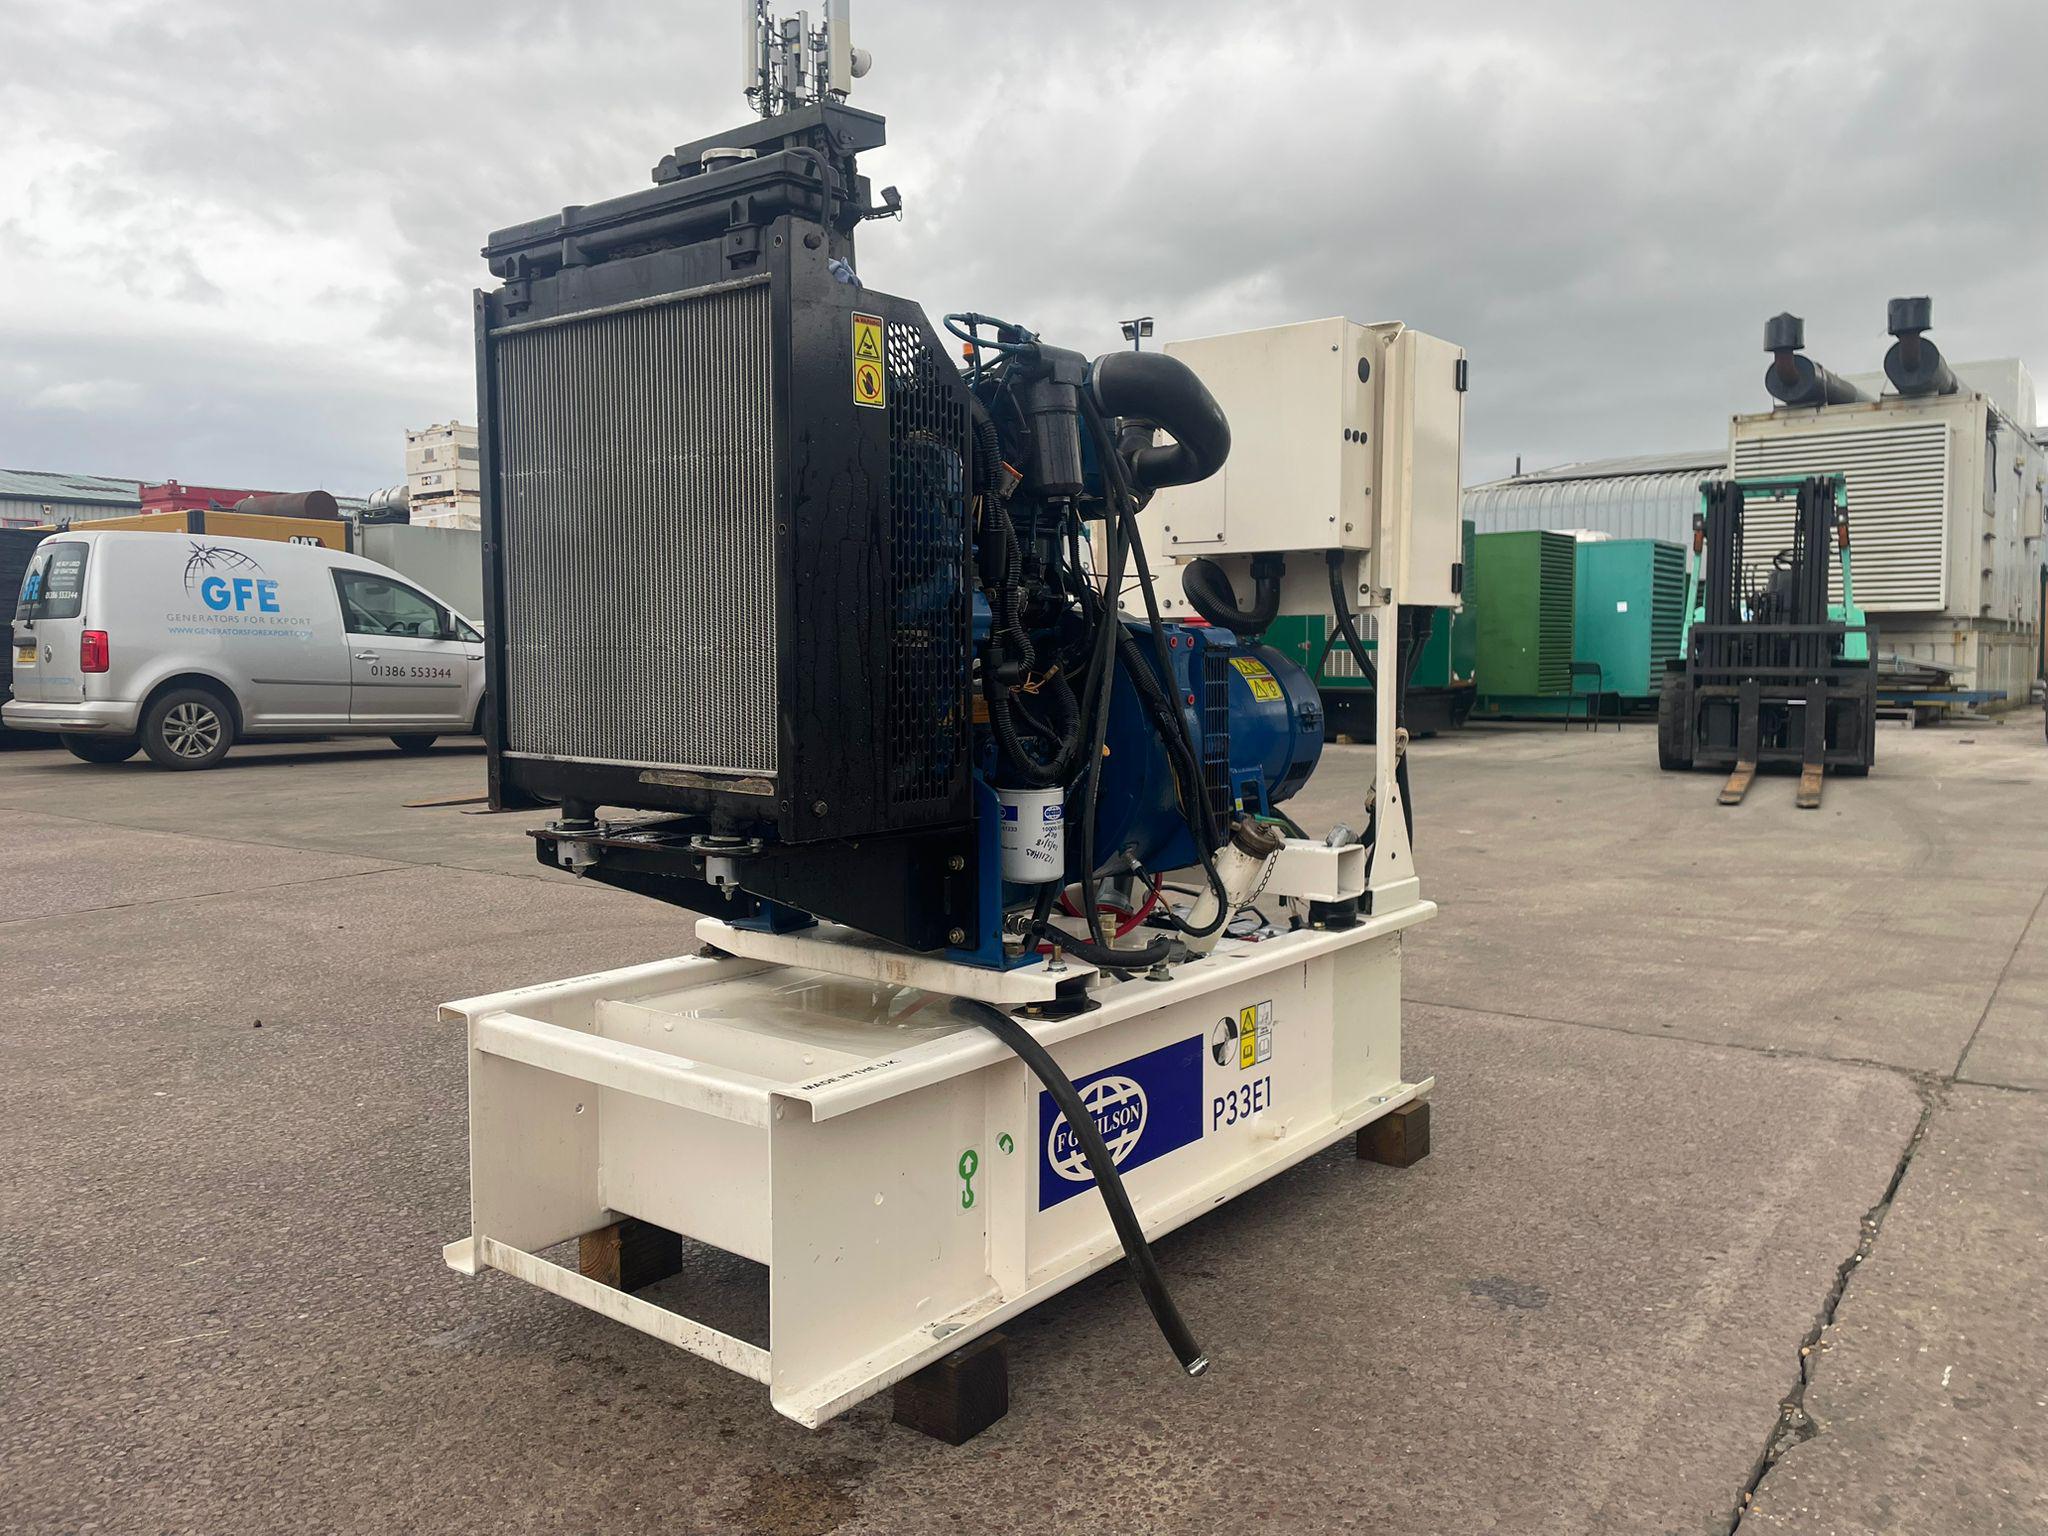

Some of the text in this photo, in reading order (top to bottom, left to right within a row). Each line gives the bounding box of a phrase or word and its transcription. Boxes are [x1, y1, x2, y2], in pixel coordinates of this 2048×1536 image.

[201, 576, 280, 612] GFE
[166, 613, 312, 626] GENERATORS FOR EXPORT
[371, 664, 453, 679] 01386 553344
[801, 1077, 840, 1091] MADE
[851, 1066, 879, 1076] THE
[1213, 1075, 1271, 1132] P33E1
